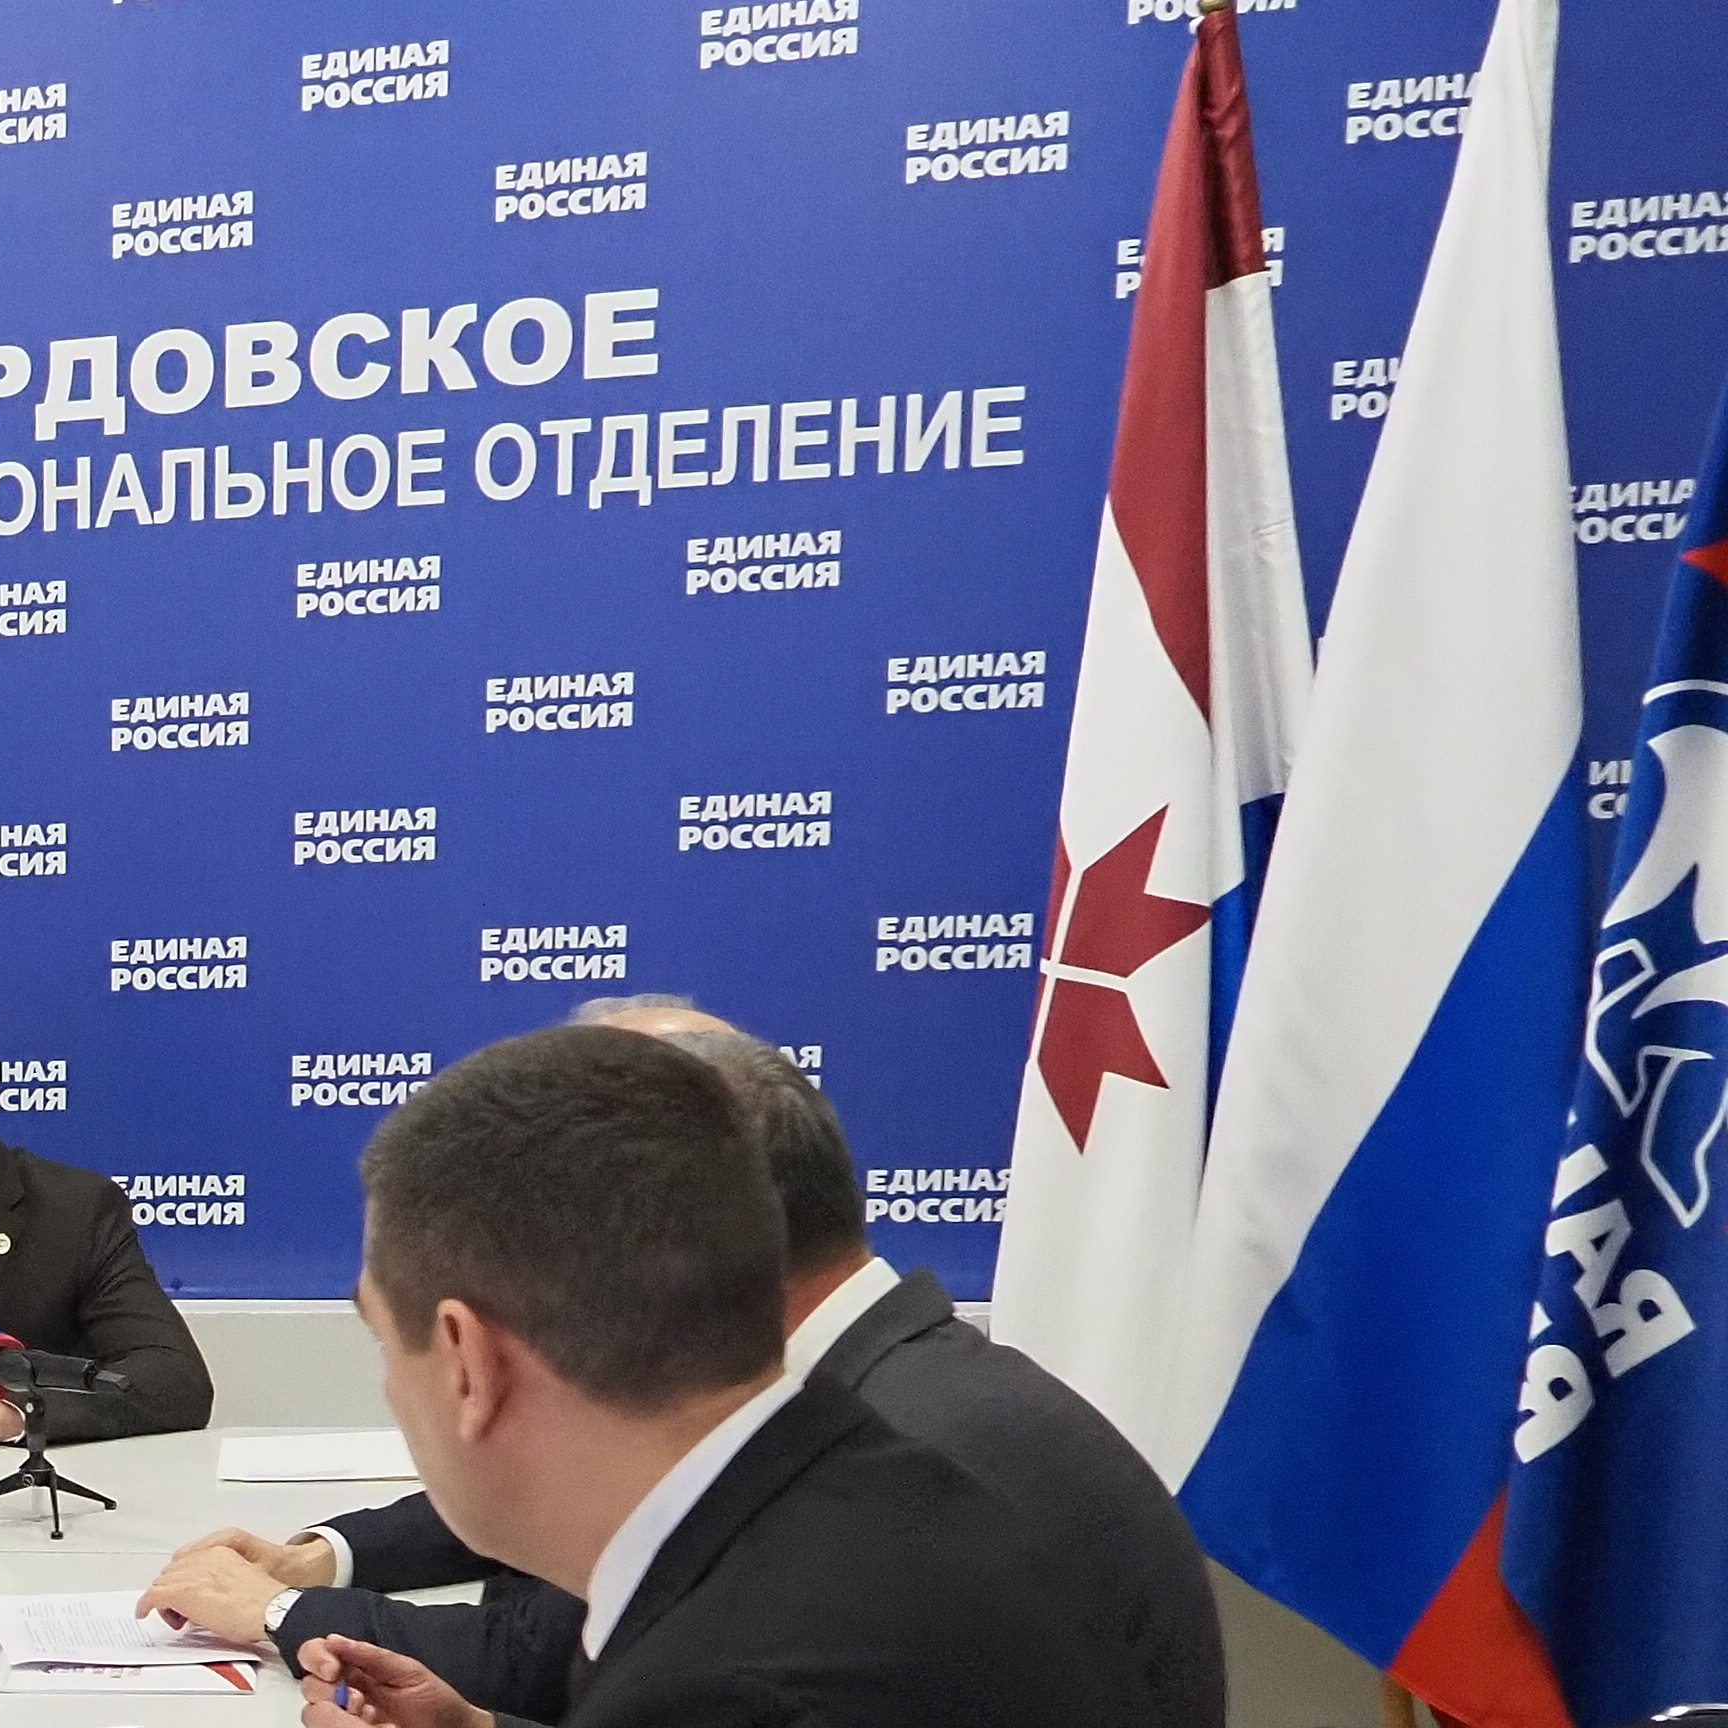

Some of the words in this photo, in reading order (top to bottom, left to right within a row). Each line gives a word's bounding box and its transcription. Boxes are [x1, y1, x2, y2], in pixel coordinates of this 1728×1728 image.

[700, 0, 859, 37] ЕДИНАЯ
[302, 40, 449, 81] ЕДИНАЯ
[700, 27, 858, 69] РОССИЯ
[301, 71, 448, 112] РОССИЯ
[1347, 74, 1474, 110] ЕДИН
[906, 111, 1069, 152] ЕДИНАЯ
[1345, 106, 1467, 144] РОСС
[495, 151, 647, 191] ЕДИНАЯ
[905, 143, 1068, 184] РОССИЯ
[112, 191, 253, 229] ЕДИНАЯ
[495, 183, 646, 222] РОССИЯ
[112, 221, 253, 259] РОССИЯ
[475, 386, 1026, 509] ОТДЕЛЕНИЕ
[1569, 478, 1695, 512] ДИНА
[1574, 513, 1687, 543] ОССИ
[687, 530, 841, 565] ЕДИНАЯ
[297, 556, 440, 589] ЕДИНАЯ
[686, 561, 840, 595] РОССИЯ
[297, 585, 440, 618] РОССИЯ
[888, 651, 1046, 684] ЕДИНАЯ
[486, 672, 634, 704] ЕДИНАЯ
[887, 682, 1044, 714] РОССИЯ
[112, 692, 249, 723] ЕДИНАЯ
[486, 702, 633, 733] РОССИЯ
[112, 721, 248, 751] РОССИЯ
[295, 807, 436, 837] ЕДИНАЯ
[680, 791, 831, 822] ЕДИНАЯ
[294, 836, 435, 865] РОССИЯ
[679, 821, 830, 851] РОССИЯ
[482, 925, 627, 953] ЕДИНАЯ
[878, 913, 1033, 942] ЕДИНАЯ
[111, 937, 246, 964] ЕДИНАЯ
[876, 944, 1031, 971] РОССИЯ
[111, 965, 246, 991] РОССИЯ
[481, 954, 626, 981] РОССИЯ
[292, 1053, 431, 1079] ЕДИНАЯ
[132, 1202, 244, 1225] ОССИЯ
